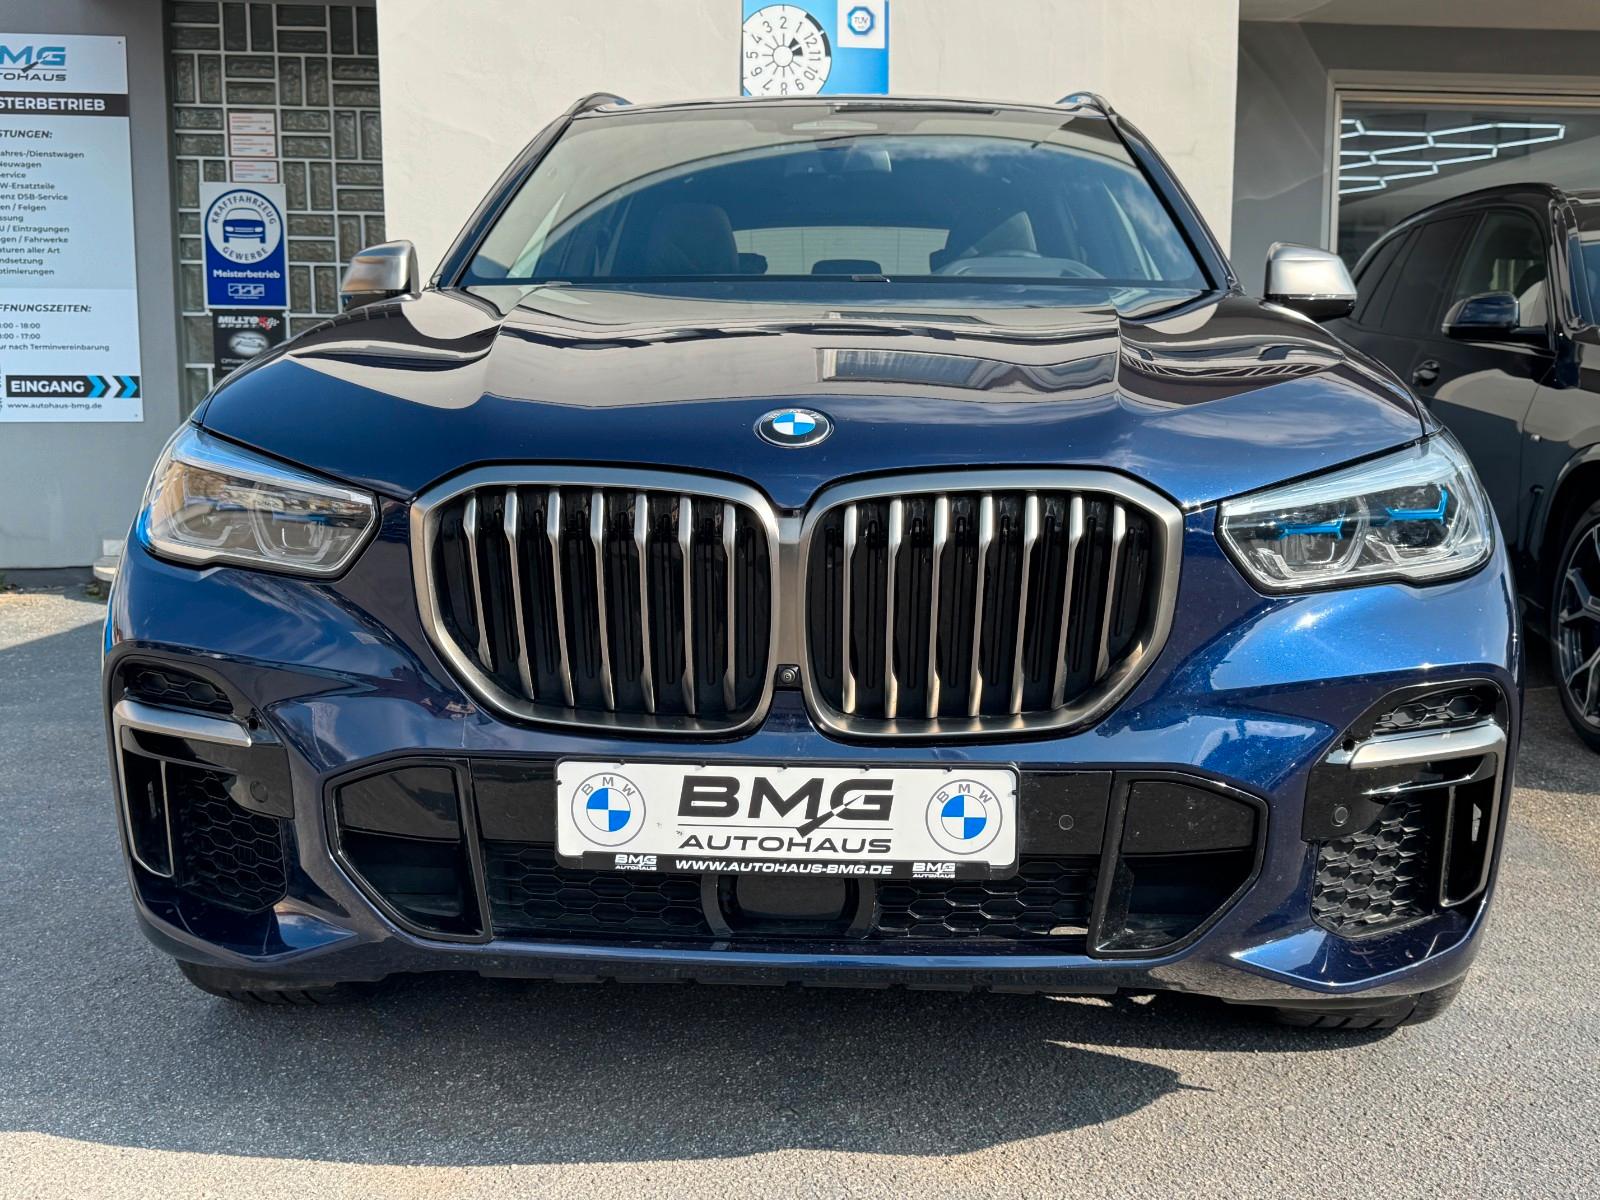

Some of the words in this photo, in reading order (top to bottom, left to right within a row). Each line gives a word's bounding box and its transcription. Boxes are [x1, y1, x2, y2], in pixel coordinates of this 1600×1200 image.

[762, 20, 773, 33] 3
[780, 16, 788, 29] 2
[795, 21, 803, 33] 1
[751, 33, 763, 44] 4
[803, 32, 818, 48] 12
[745, 51, 759, 59] 5
[808, 50, 821, 61] 11
[0, 73, 67, 81] OHAUS
[803, 66, 819, 81] 10
[762, 78, 773, 91] 7
[780, 82, 788, 95] 8
[0, 150, 85, 159] ahres-/Dienstwagen
[18, 204, 47, 212] Felgen
[211, 195, 277, 225] KRAFTFAHRZEUG
[12, 225, 70, 233] Eintragungen
[24, 235, 69, 243] Fahrwerke
[222, 246, 268, 261] GEWERBE
[213, 269, 281, 279] Meisterbetrieb
[9, 343, 29, 351] nach
[30, 343, 110, 352] Terminvereinbarung
[10, 380, 85, 393] EINGANG
[7, 402, 103, 410] www.autohaus-bmg.de
[580, 776, 636, 797] BMW
[677, 775, 894, 821] BMG
[936, 783, 992, 804] BMW
[677, 834, 892, 854] AUTOHAUS
[614, 854, 658, 865] BMG
[675, 859, 894, 875] WWW.AUTOHAUS-BMG.DE
[912, 862, 956, 873] BMG
